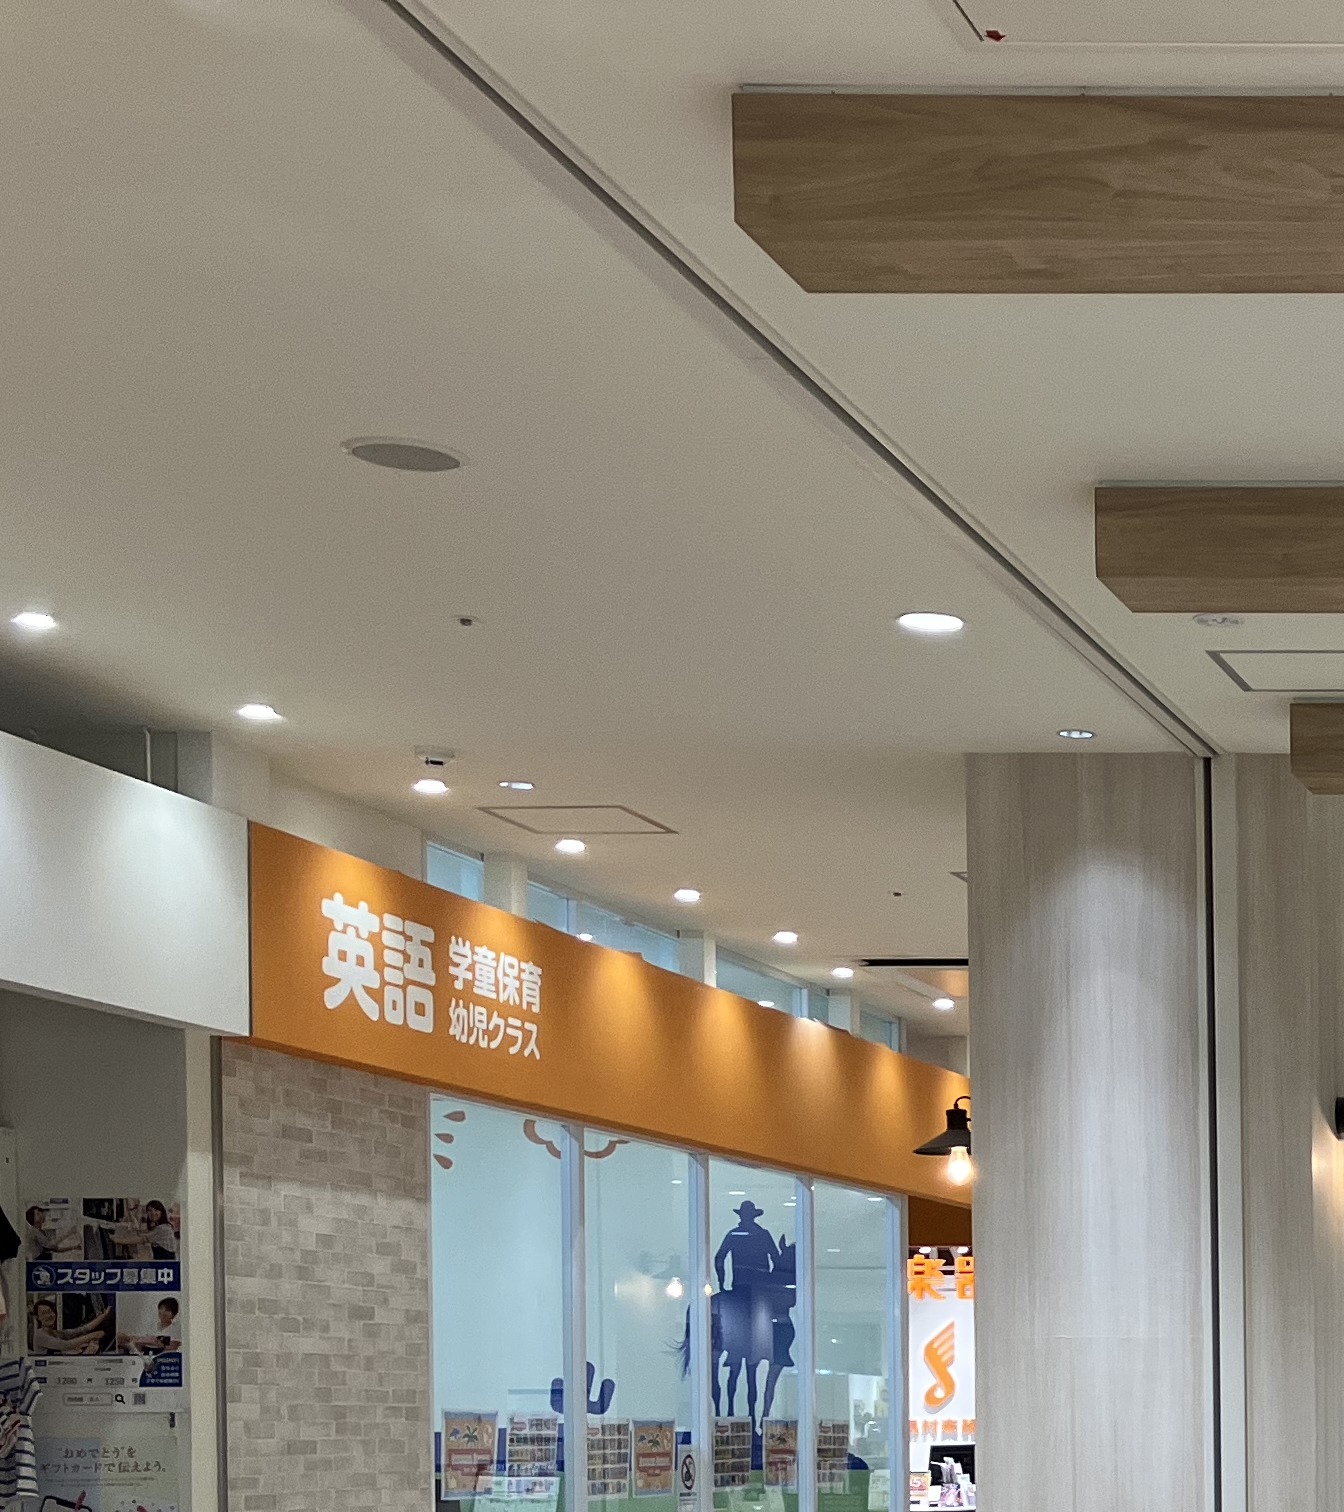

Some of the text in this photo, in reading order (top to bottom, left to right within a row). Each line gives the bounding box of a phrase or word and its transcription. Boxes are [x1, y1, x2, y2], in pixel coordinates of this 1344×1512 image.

[321, 892, 436, 1035] 英語
[448, 936, 543, 1014] 学童保育
[448, 998, 541, 1060] 幼児クラス
[56, 1267, 174, 1285] スタッフ募集中
